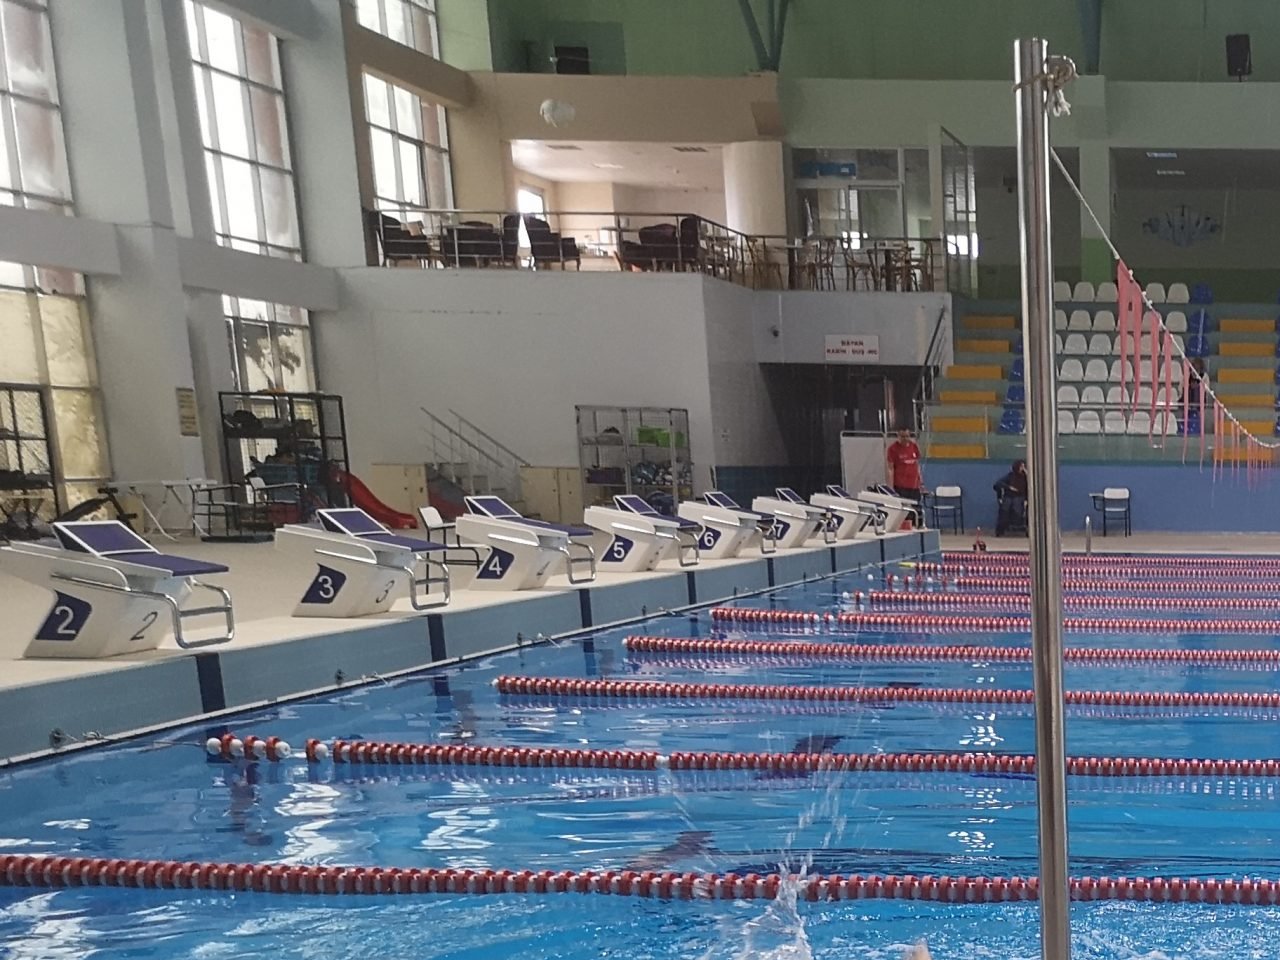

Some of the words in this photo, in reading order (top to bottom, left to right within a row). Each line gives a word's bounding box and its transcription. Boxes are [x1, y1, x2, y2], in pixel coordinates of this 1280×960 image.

[703, 531, 716, 547] 6
[775, 523, 785, 538] 7
[613, 541, 625, 559] 5
[488, 555, 503, 576] 4
[318, 575, 335, 599] 3
[375, 579, 396, 604] 3
[55, 605, 77, 635] 2
[129, 610, 159, 642] 2
